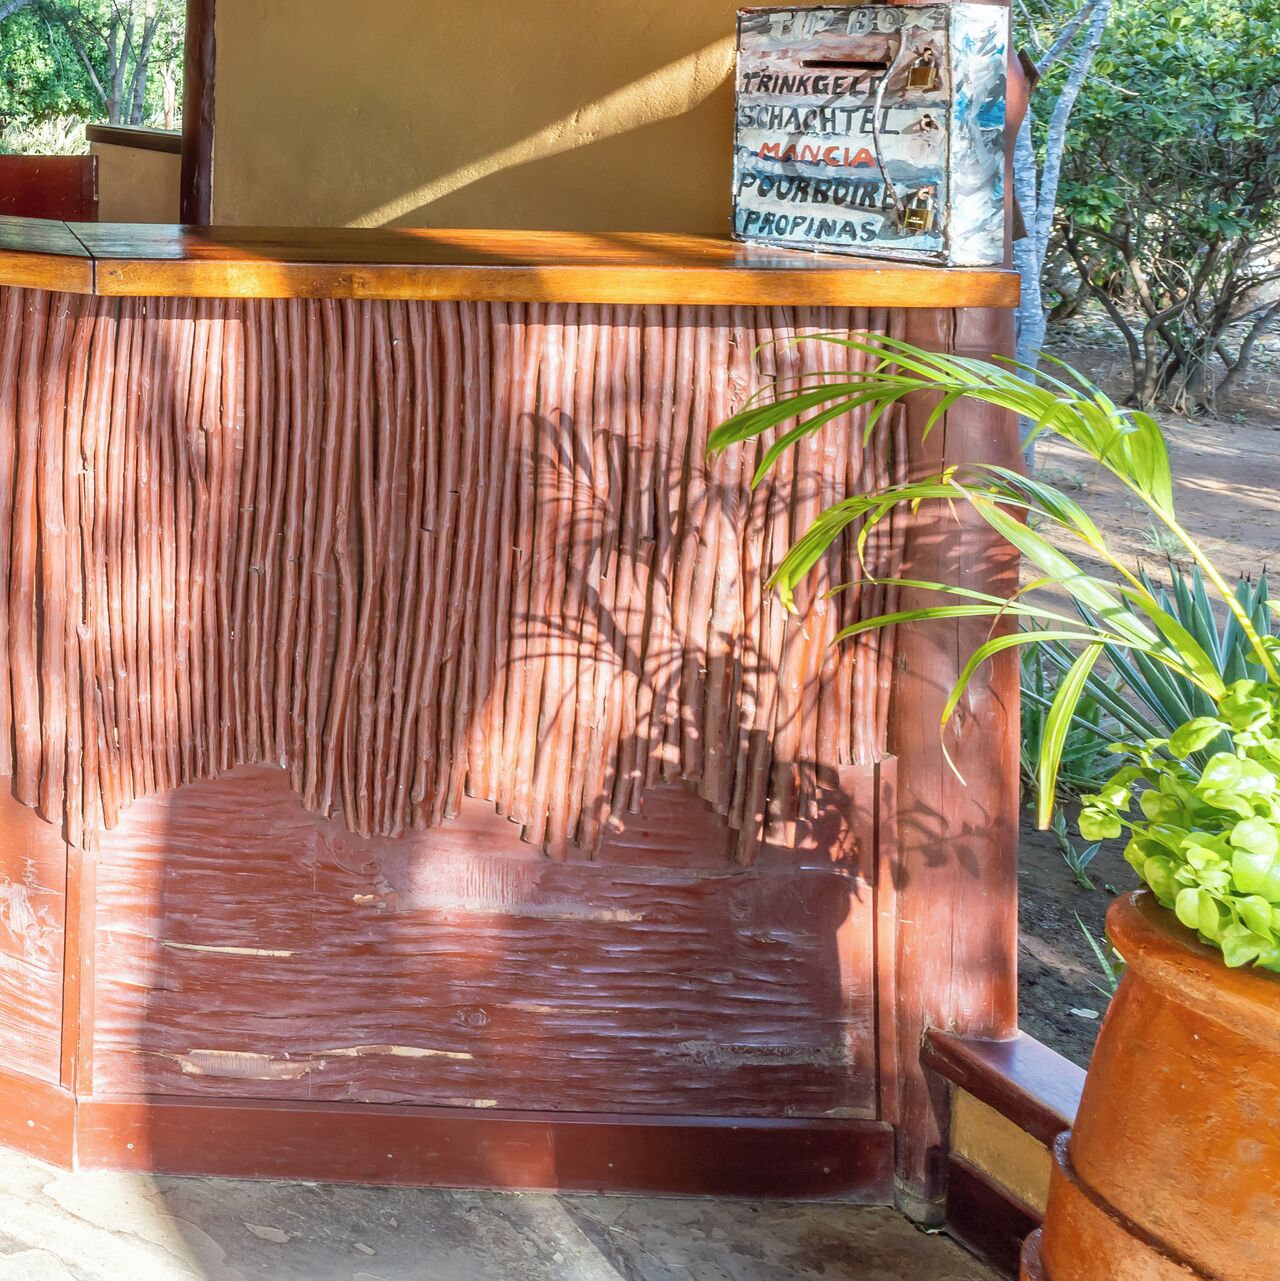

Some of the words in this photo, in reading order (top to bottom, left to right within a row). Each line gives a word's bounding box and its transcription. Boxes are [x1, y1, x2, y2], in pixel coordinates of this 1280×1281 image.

[769, 10, 835, 40] TIP
[846, 8, 937, 37] BOX
[741, 71, 888, 95] TRINKGELD
[740, 105, 900, 135] SCHACHTEL
[757, 142, 877, 168] MANCIA
[739, 171, 897, 211] POURBOIRE
[743, 211, 879, 242] PROPINAS
